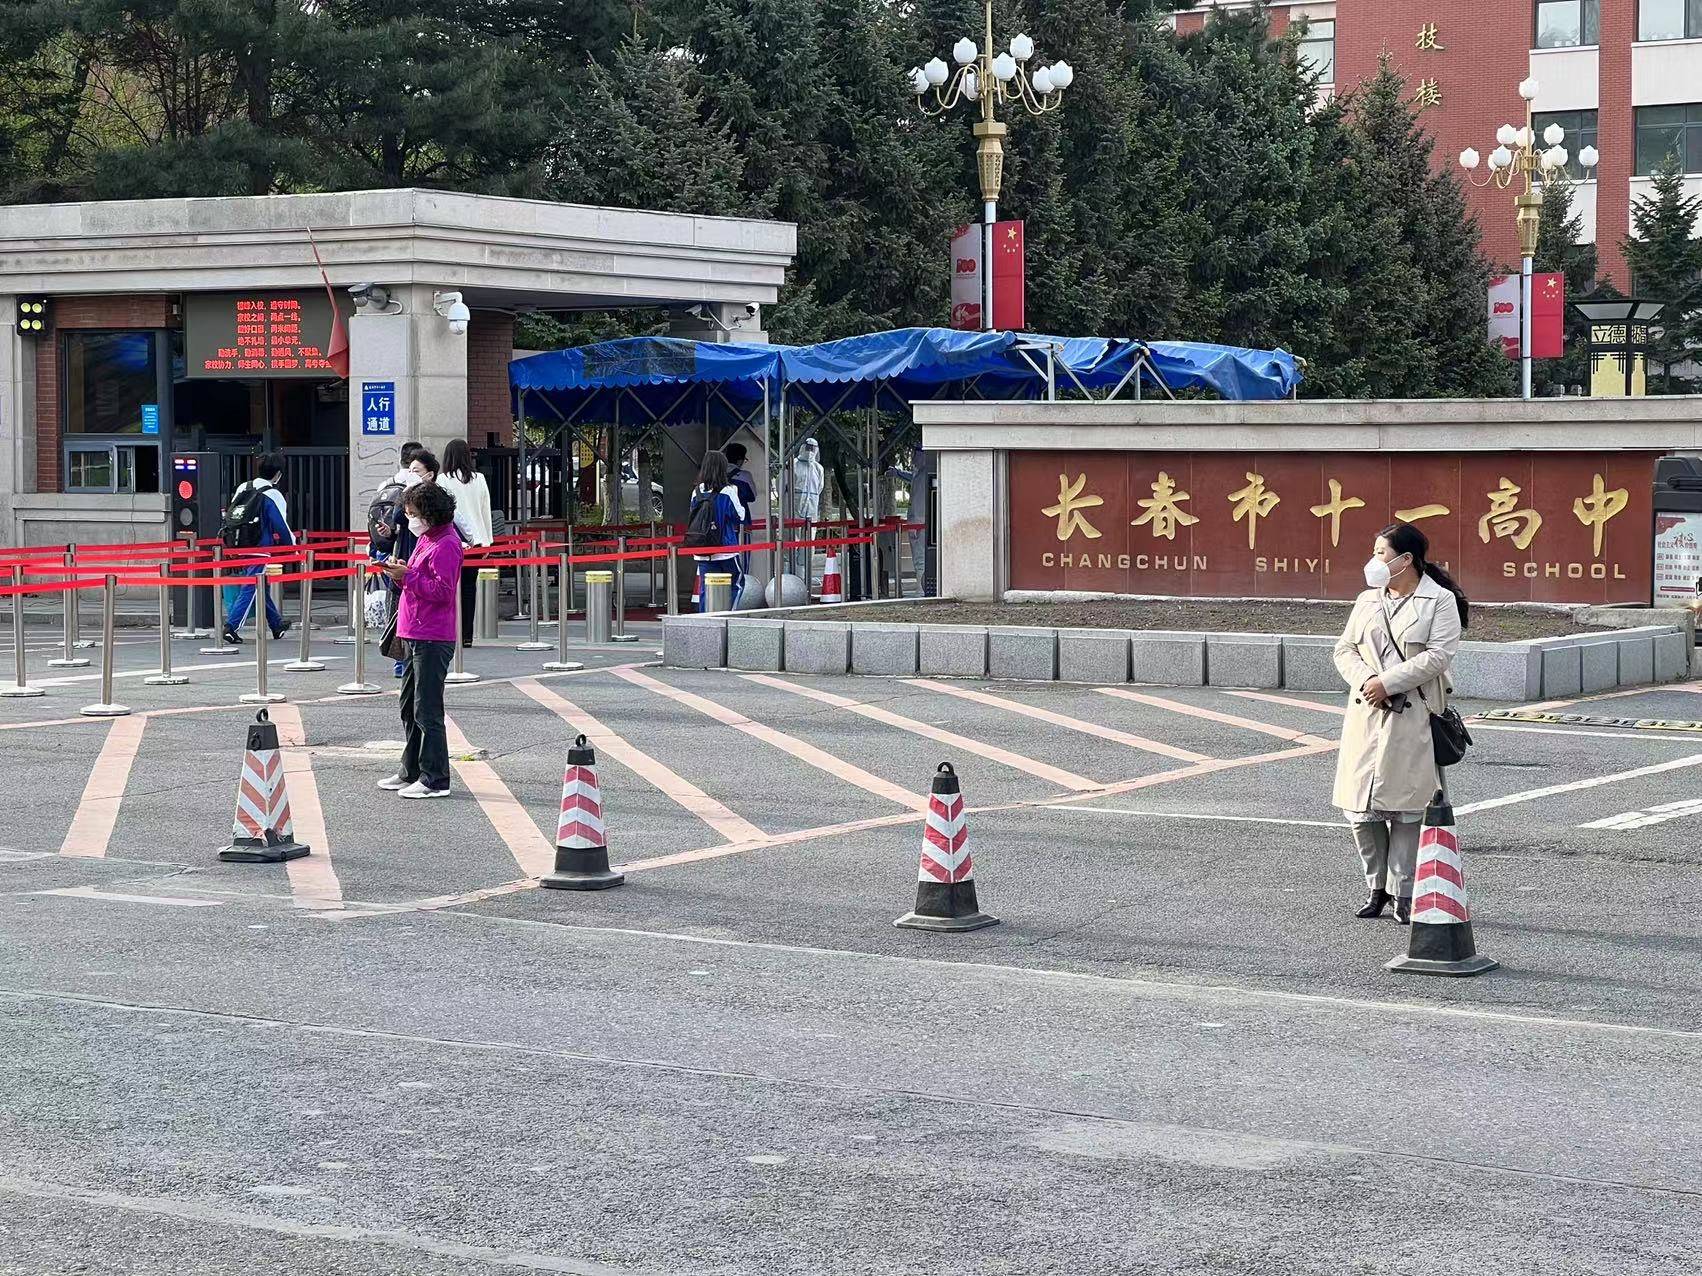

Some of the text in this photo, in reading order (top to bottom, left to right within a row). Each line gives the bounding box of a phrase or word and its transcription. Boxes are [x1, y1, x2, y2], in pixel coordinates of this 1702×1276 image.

[367, 397, 390, 412] 人行
[367, 417, 390, 431] 通道
[1041, 471, 1629, 558] 长春市十一高中
[1042, 552, 1626, 580] CHANGCHUN SHIYI SCHOOL
